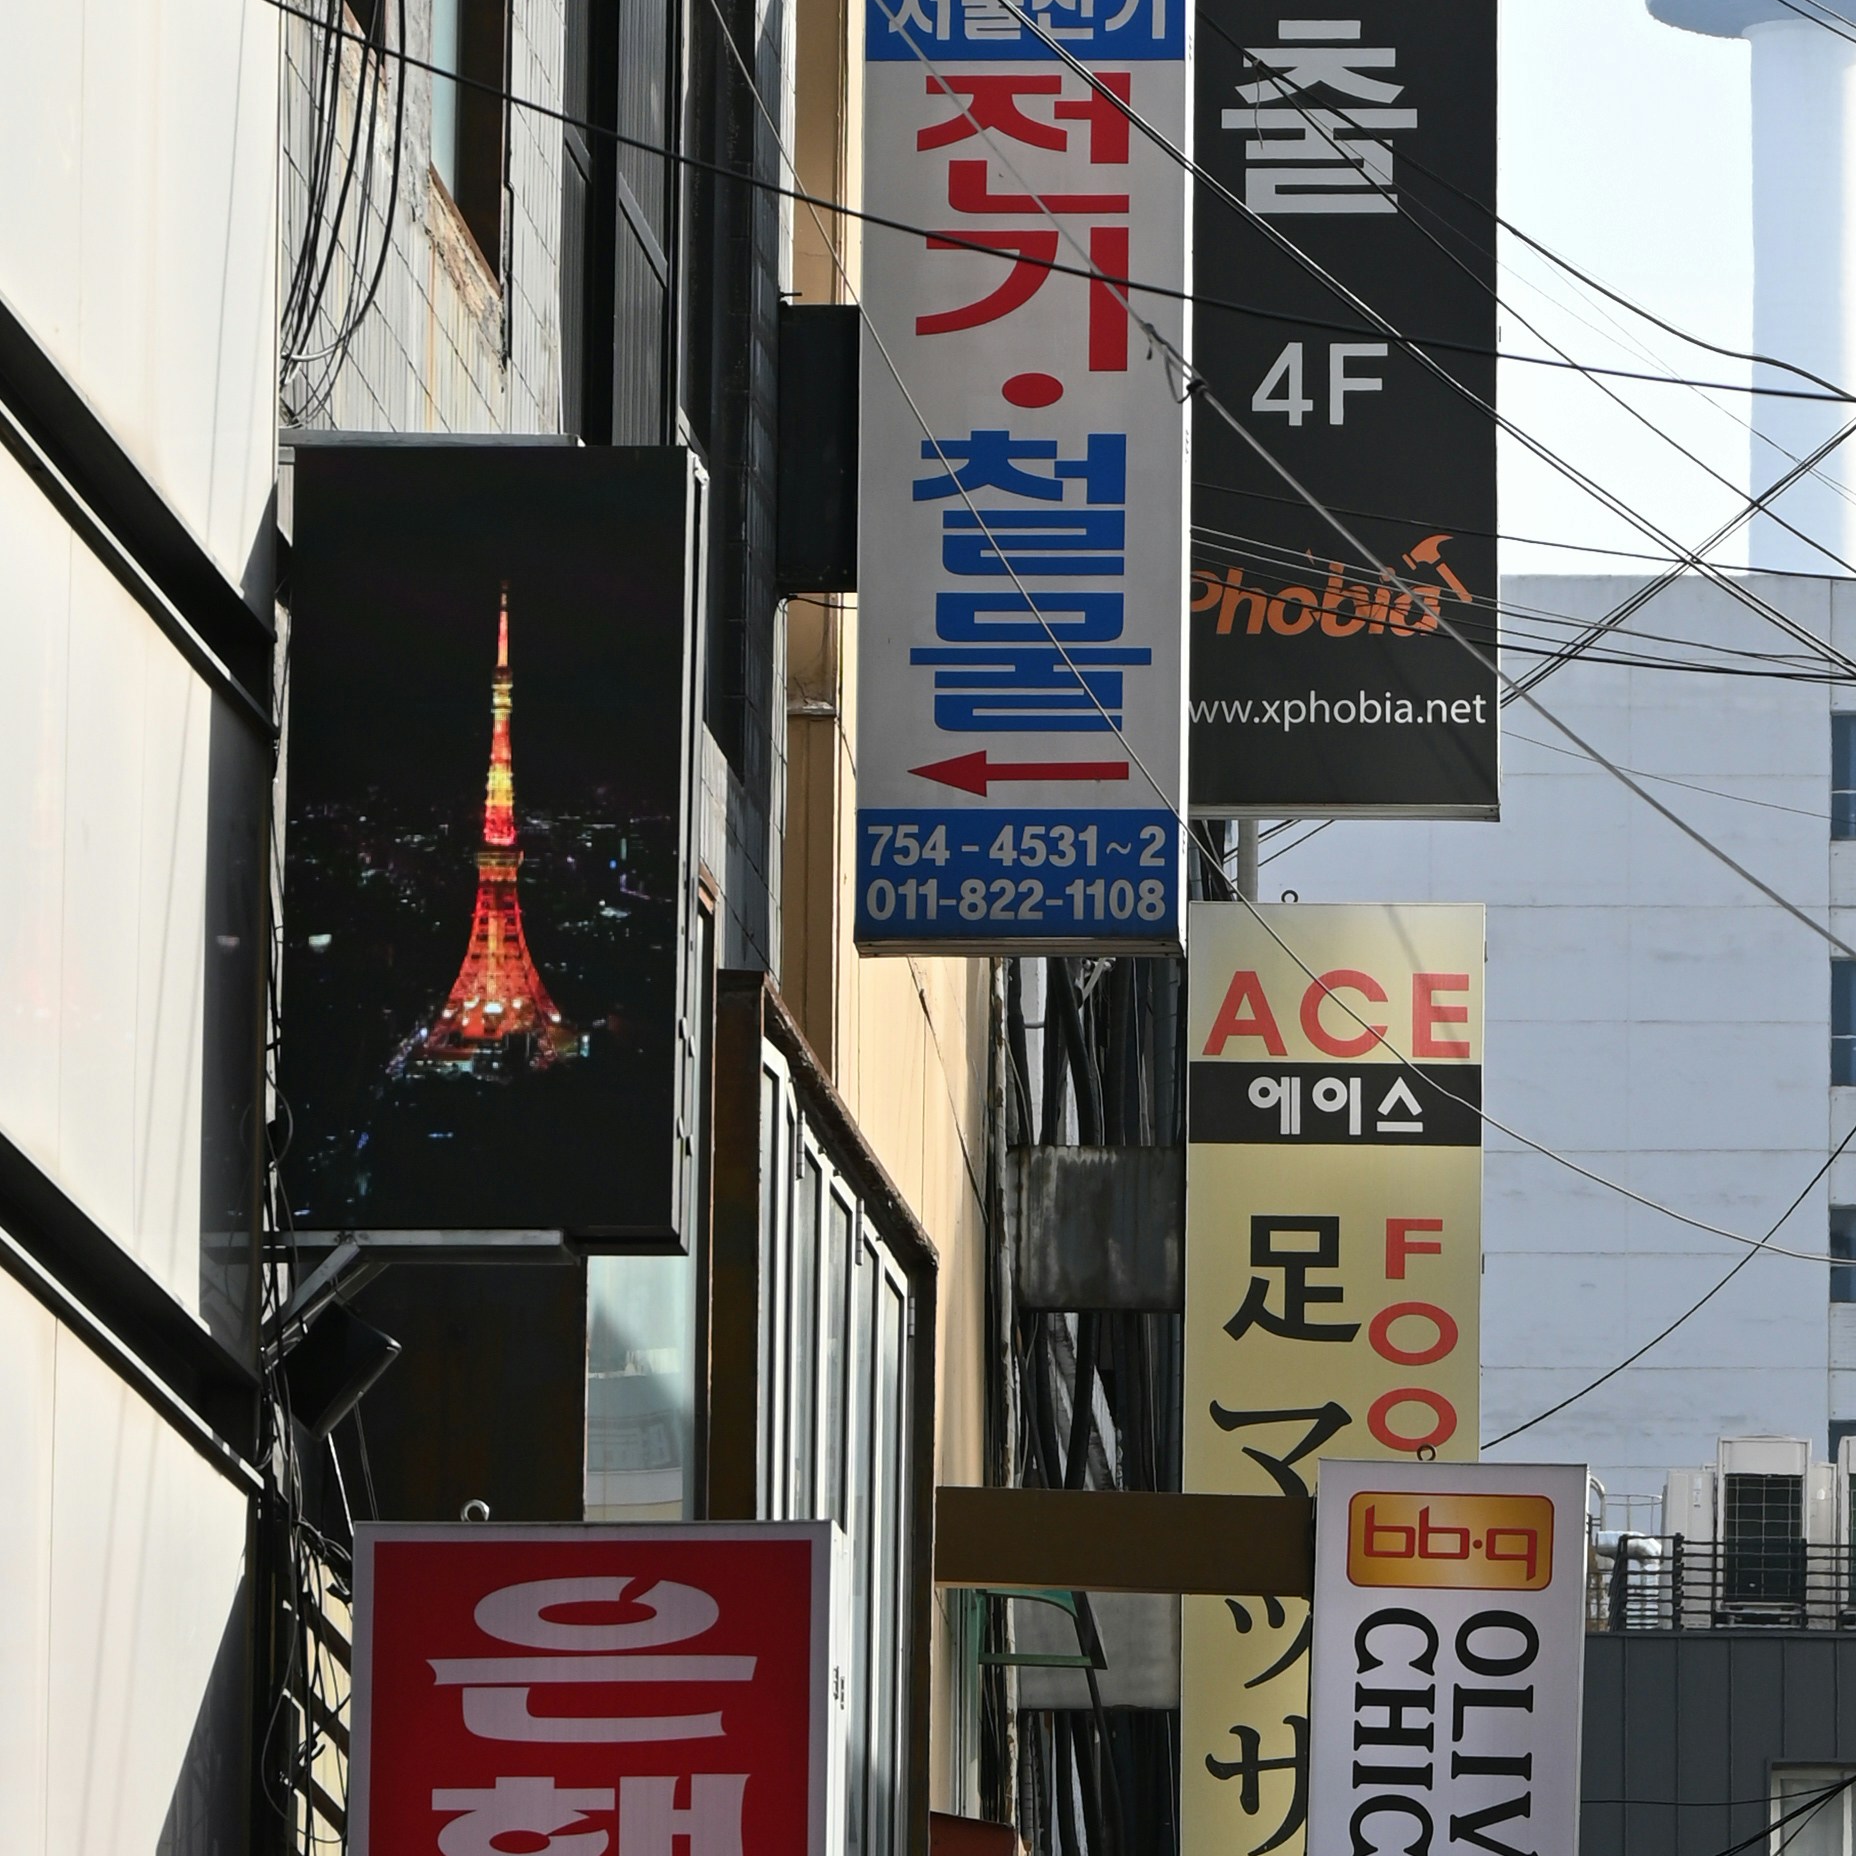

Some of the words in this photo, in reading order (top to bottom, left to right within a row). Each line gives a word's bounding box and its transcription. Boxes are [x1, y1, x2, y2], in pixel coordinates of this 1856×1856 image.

[1251, 341, 1389, 426] 4F
[866, 879, 1167, 923] 011-822-1108
[1201, 968, 1470, 1059] ACE
[1248, 1076, 1424, 1136] 에이스
